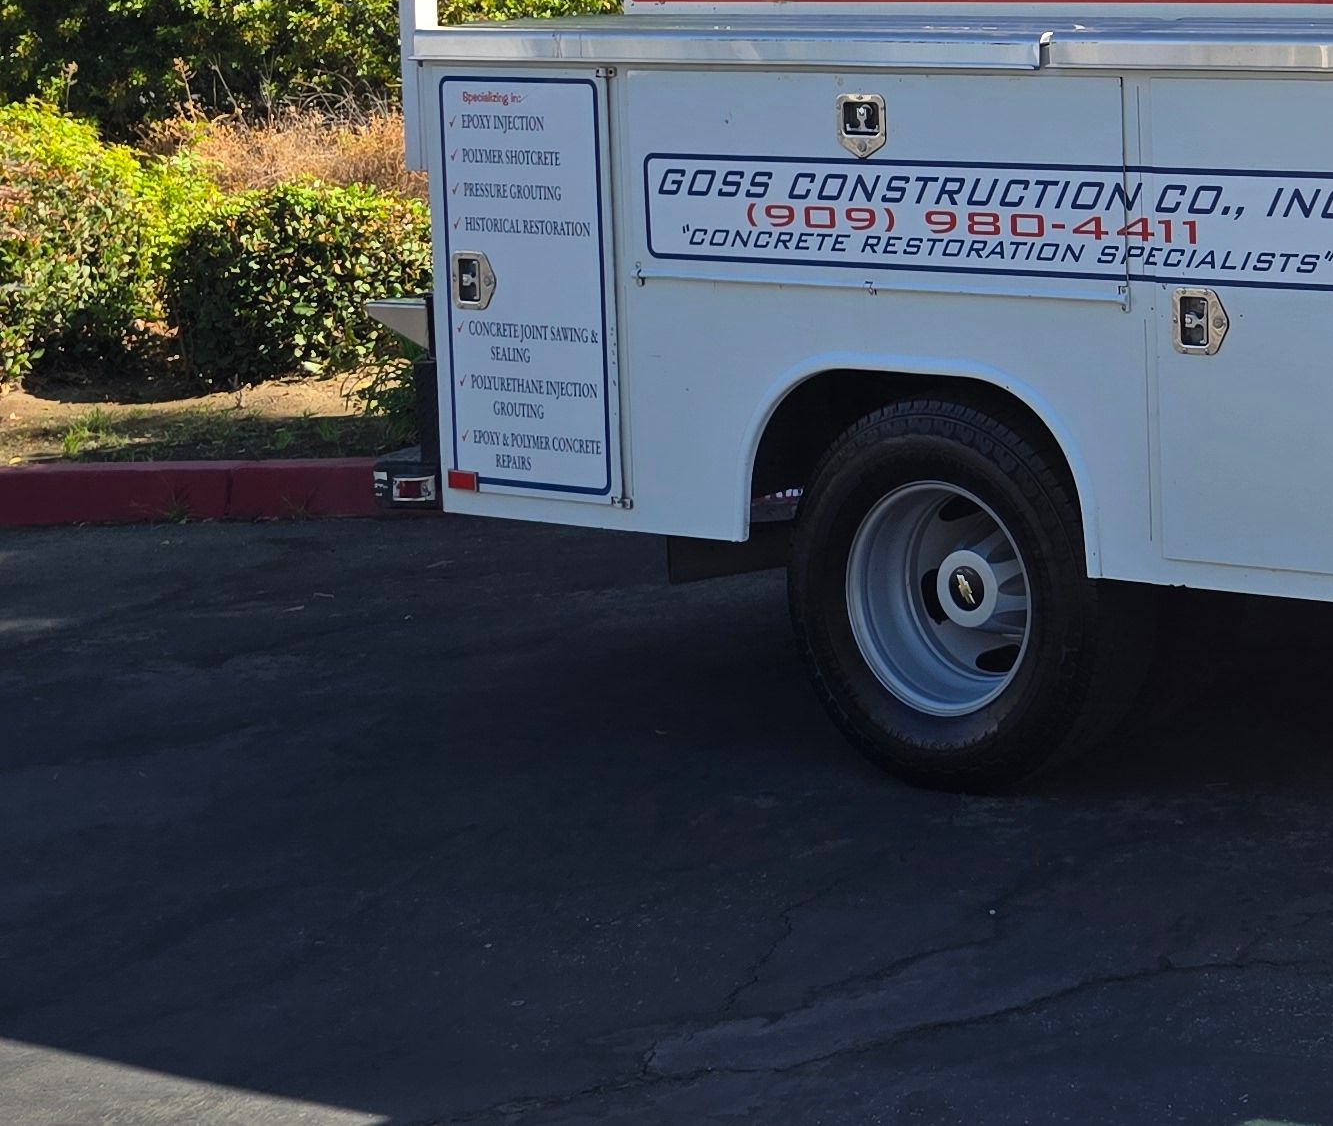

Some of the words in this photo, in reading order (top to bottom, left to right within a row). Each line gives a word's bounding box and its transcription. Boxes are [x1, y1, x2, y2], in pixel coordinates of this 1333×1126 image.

[462, 91, 509, 106] Specializing
[461, 114, 492, 130] EPOXY
[493, 115, 545, 133] INJECTION
[462, 148, 505, 164] POLYMER
[505, 149, 561, 166] SHOTCRETE
[463, 182, 508, 199] PRESSURE
[509, 183, 562, 201] GROUTING
[658, 168, 774, 198] GOSS
[788, 172, 1143, 212] CONSTRUCTION
[1155, 184, 1245, 221] CO.,
[465, 216, 521, 234] HISTORICAL
[522, 219, 591, 237] RESTORATION
[747, 202, 895, 233] (909)
[924, 209, 1197, 245] 980-4411
[682, 223, 852, 253] "CONCRETE
[860, 235, 1085, 263] RESTORATION
[468, 320, 520, 338] CONCRETE
[520, 324, 549, 342] JOINT
[550, 326, 589, 344] SAWING
[590, 330, 599, 344] &
[490, 345, 531, 363] SEALING
[471, 374, 544, 395] POLYURETHANE
[546, 380, 598, 400] INJECTION
[493, 400, 545, 420] GROUTING
[473, 429, 501, 446] EPOXY
[502, 434, 510, 447] &
[511, 433, 551, 451] POLYMER
[552, 436, 602, 455] CONCRETE
[495, 453, 532, 471] REPAIRS
